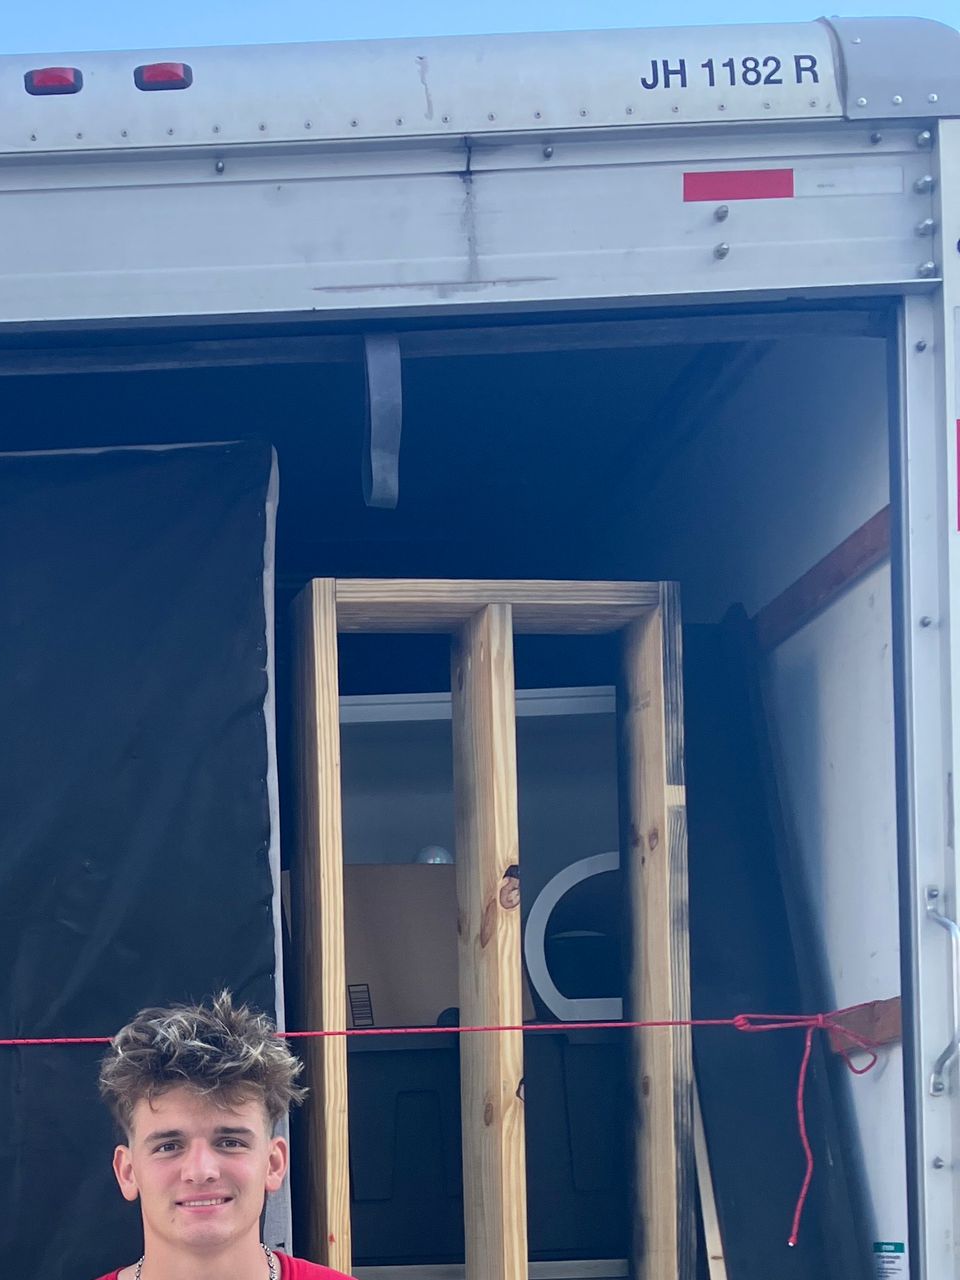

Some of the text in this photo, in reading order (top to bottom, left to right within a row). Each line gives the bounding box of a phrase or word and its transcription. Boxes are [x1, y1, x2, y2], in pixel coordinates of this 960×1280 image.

[640, 54, 819, 89] JH 1182 R
